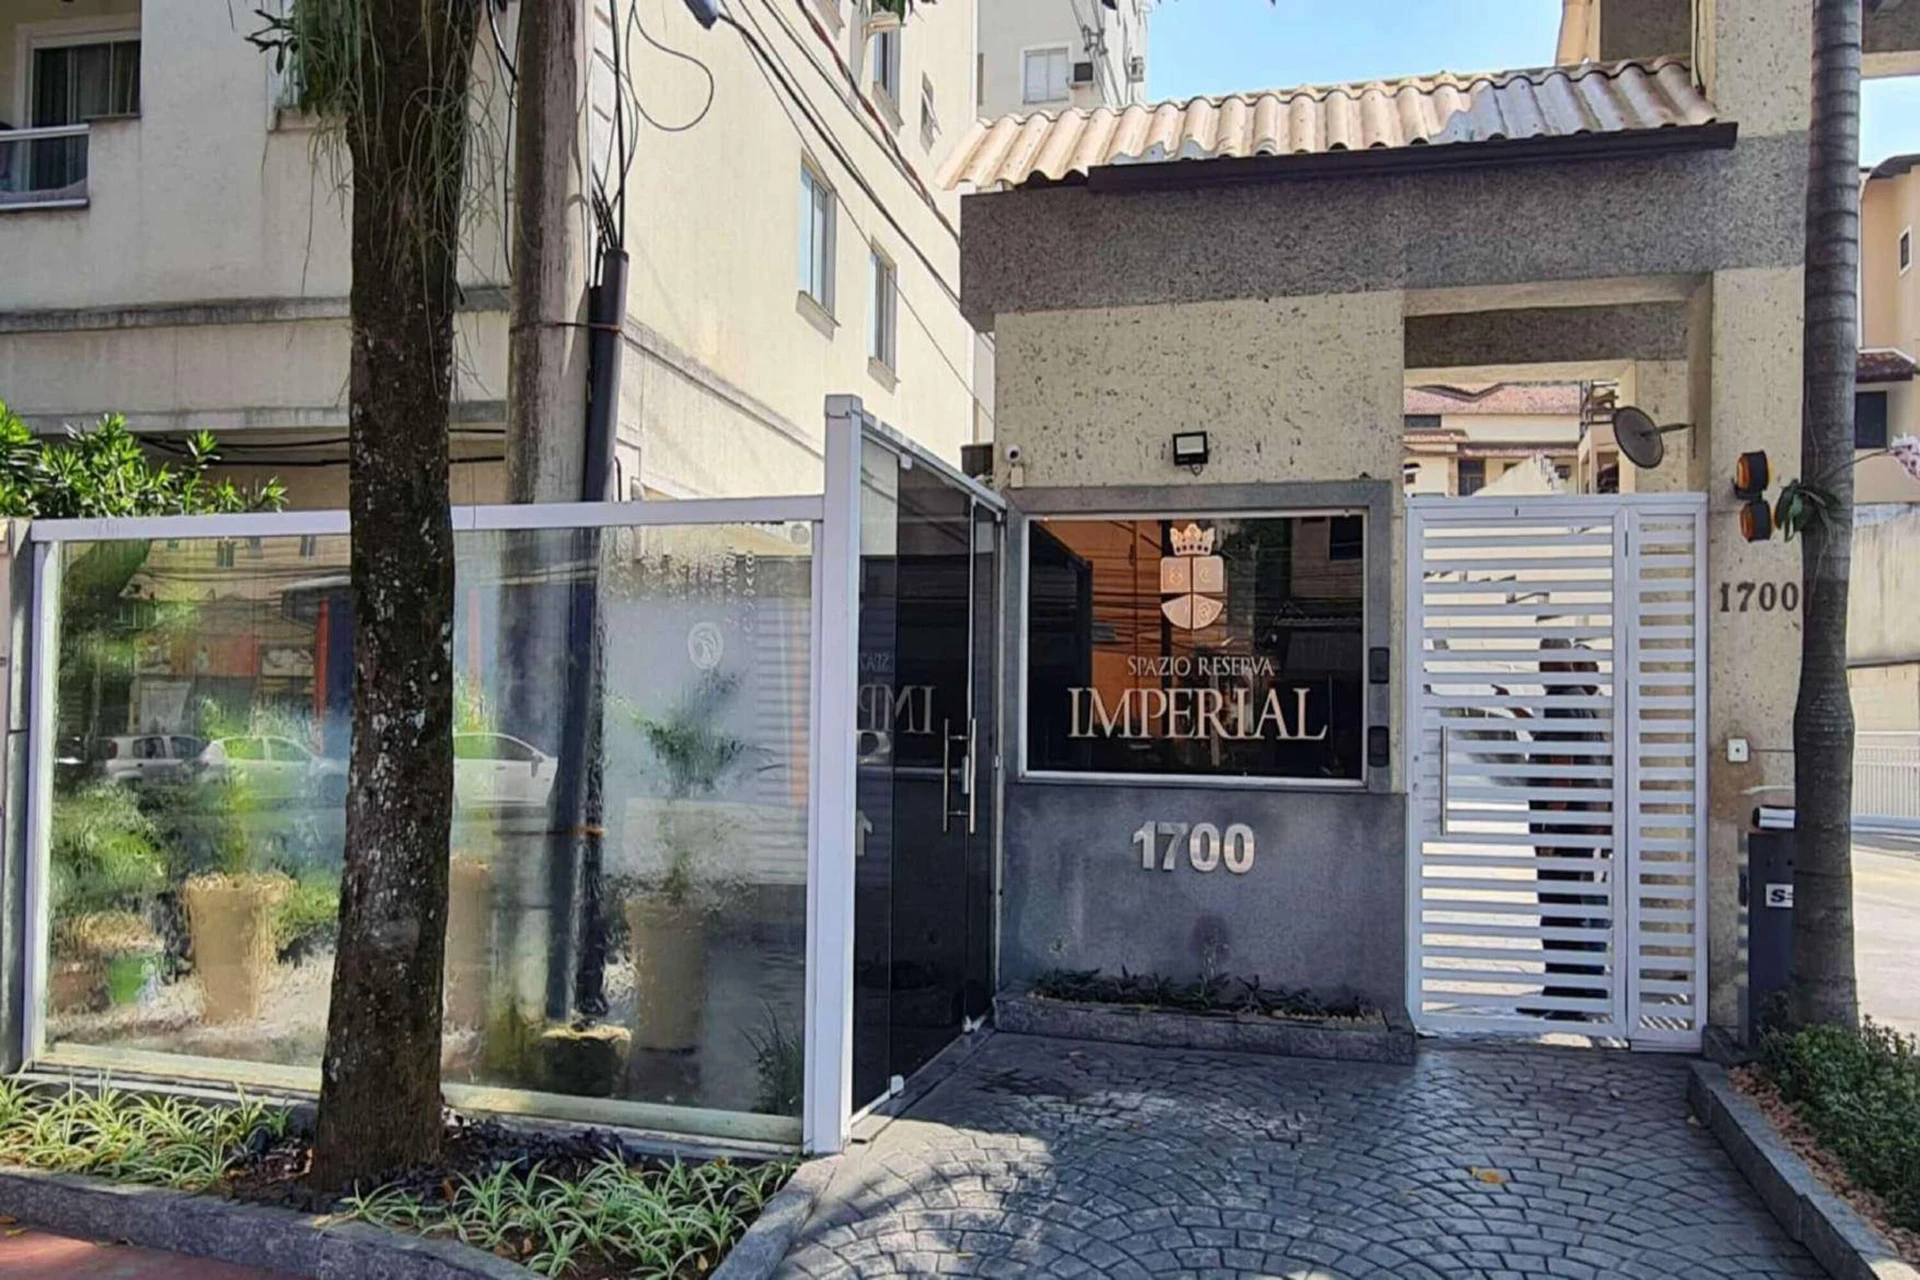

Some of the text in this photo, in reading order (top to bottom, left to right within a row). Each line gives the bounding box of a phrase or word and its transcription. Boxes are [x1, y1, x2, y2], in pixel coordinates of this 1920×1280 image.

[1720, 581, 1799, 612] 1700
[1127, 655, 1275, 677] SPAZIO RESERVA
[1067, 687, 1328, 741] IMPERIAL
[1132, 820, 1255, 874] 1700
